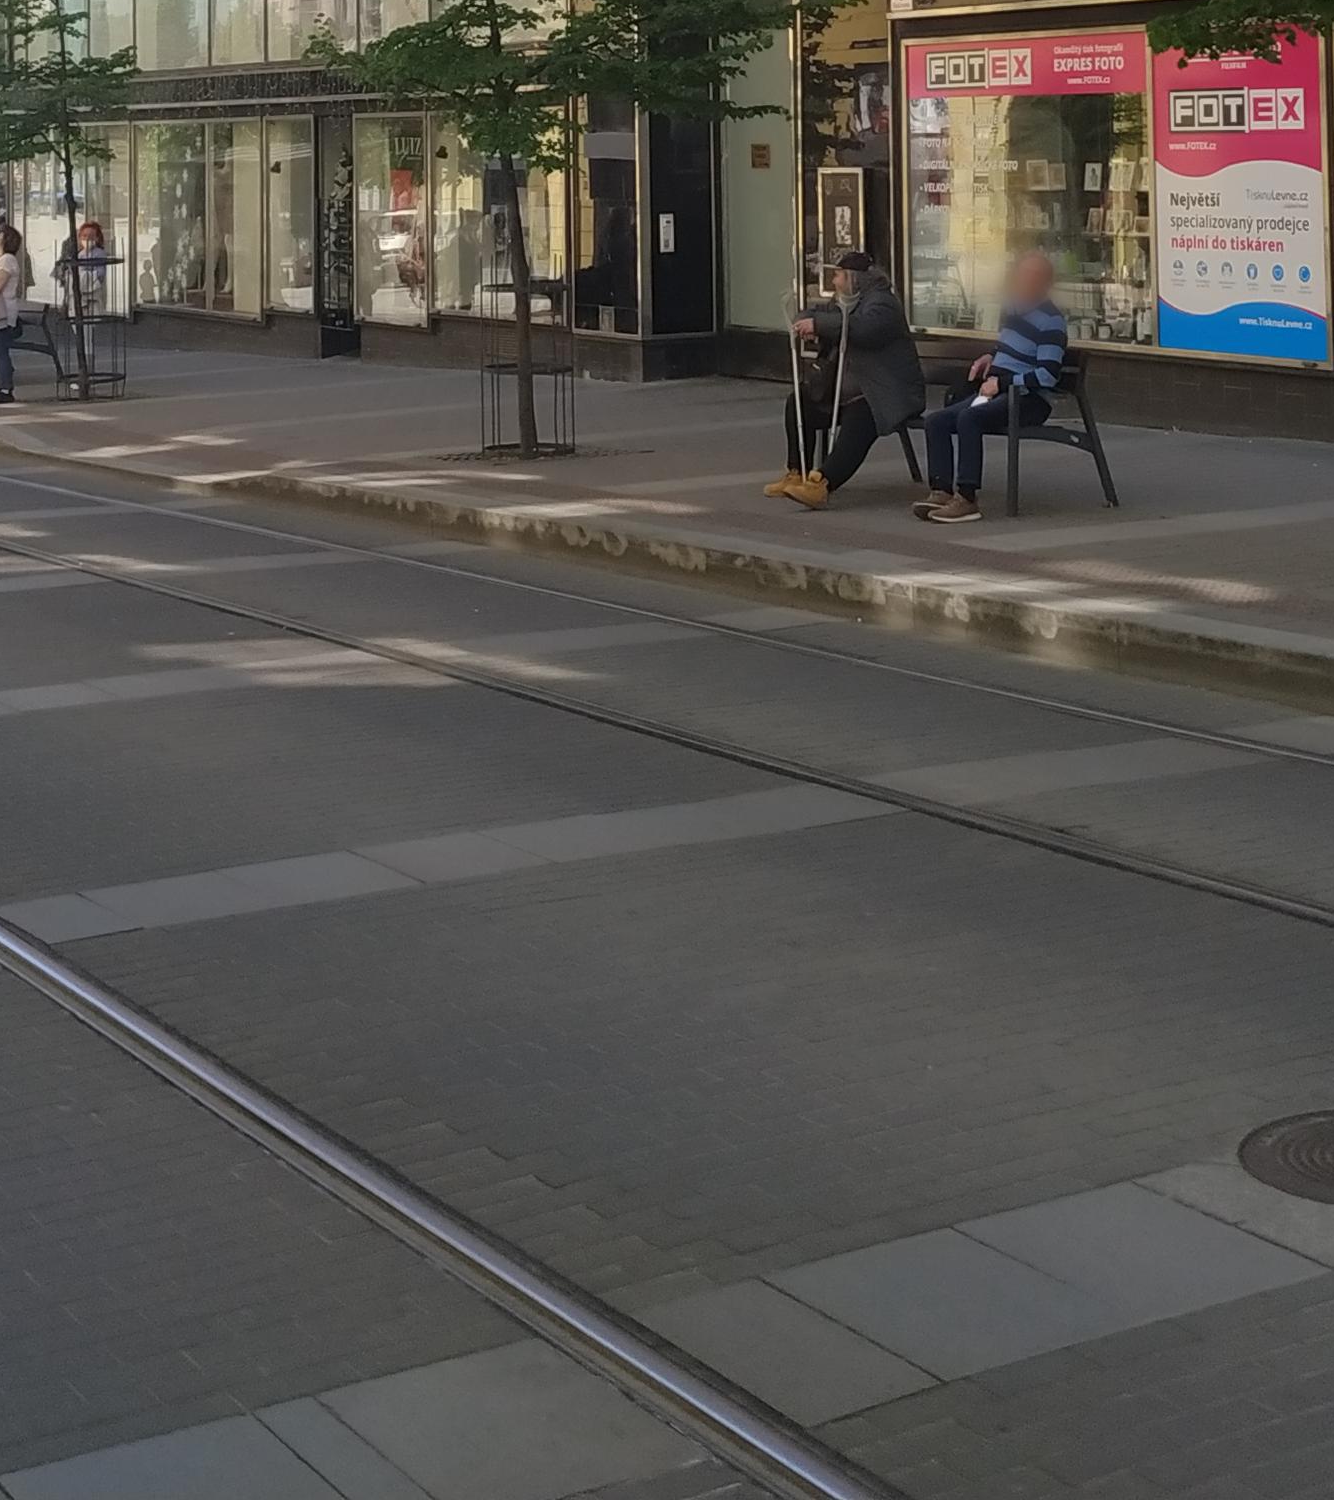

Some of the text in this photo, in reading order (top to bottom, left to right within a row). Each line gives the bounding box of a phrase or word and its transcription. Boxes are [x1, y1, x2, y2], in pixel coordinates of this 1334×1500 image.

[927, 50, 1030, 88] FOTEX
[1053, 56, 1124, 72] EXPRES FOTO
[1171, 90, 1304, 131] FOTEX
[1170, 192, 1221, 211] Největší
[1170, 214, 1310, 235] specializovaný prodejce
[1171, 235, 1284, 253] náplní do tiskáren
